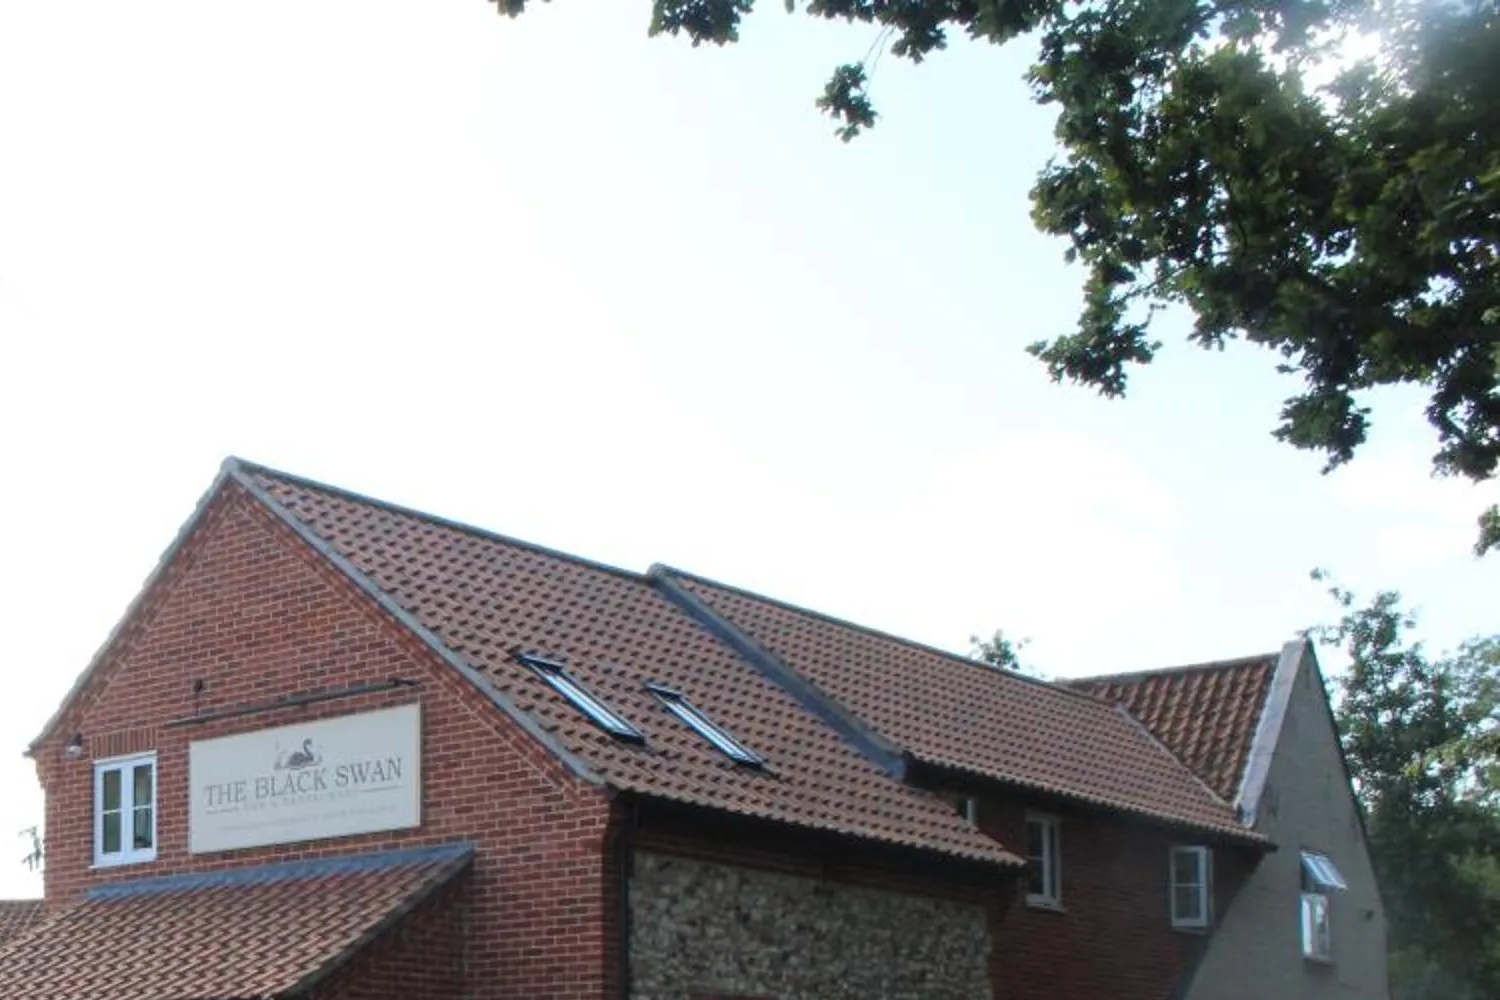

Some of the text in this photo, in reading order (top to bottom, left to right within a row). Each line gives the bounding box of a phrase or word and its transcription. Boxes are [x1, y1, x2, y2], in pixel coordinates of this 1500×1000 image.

[205, 781, 246, 806] THE
[255, 768, 327, 799] BLACK
[335, 757, 401, 786] SWAN
